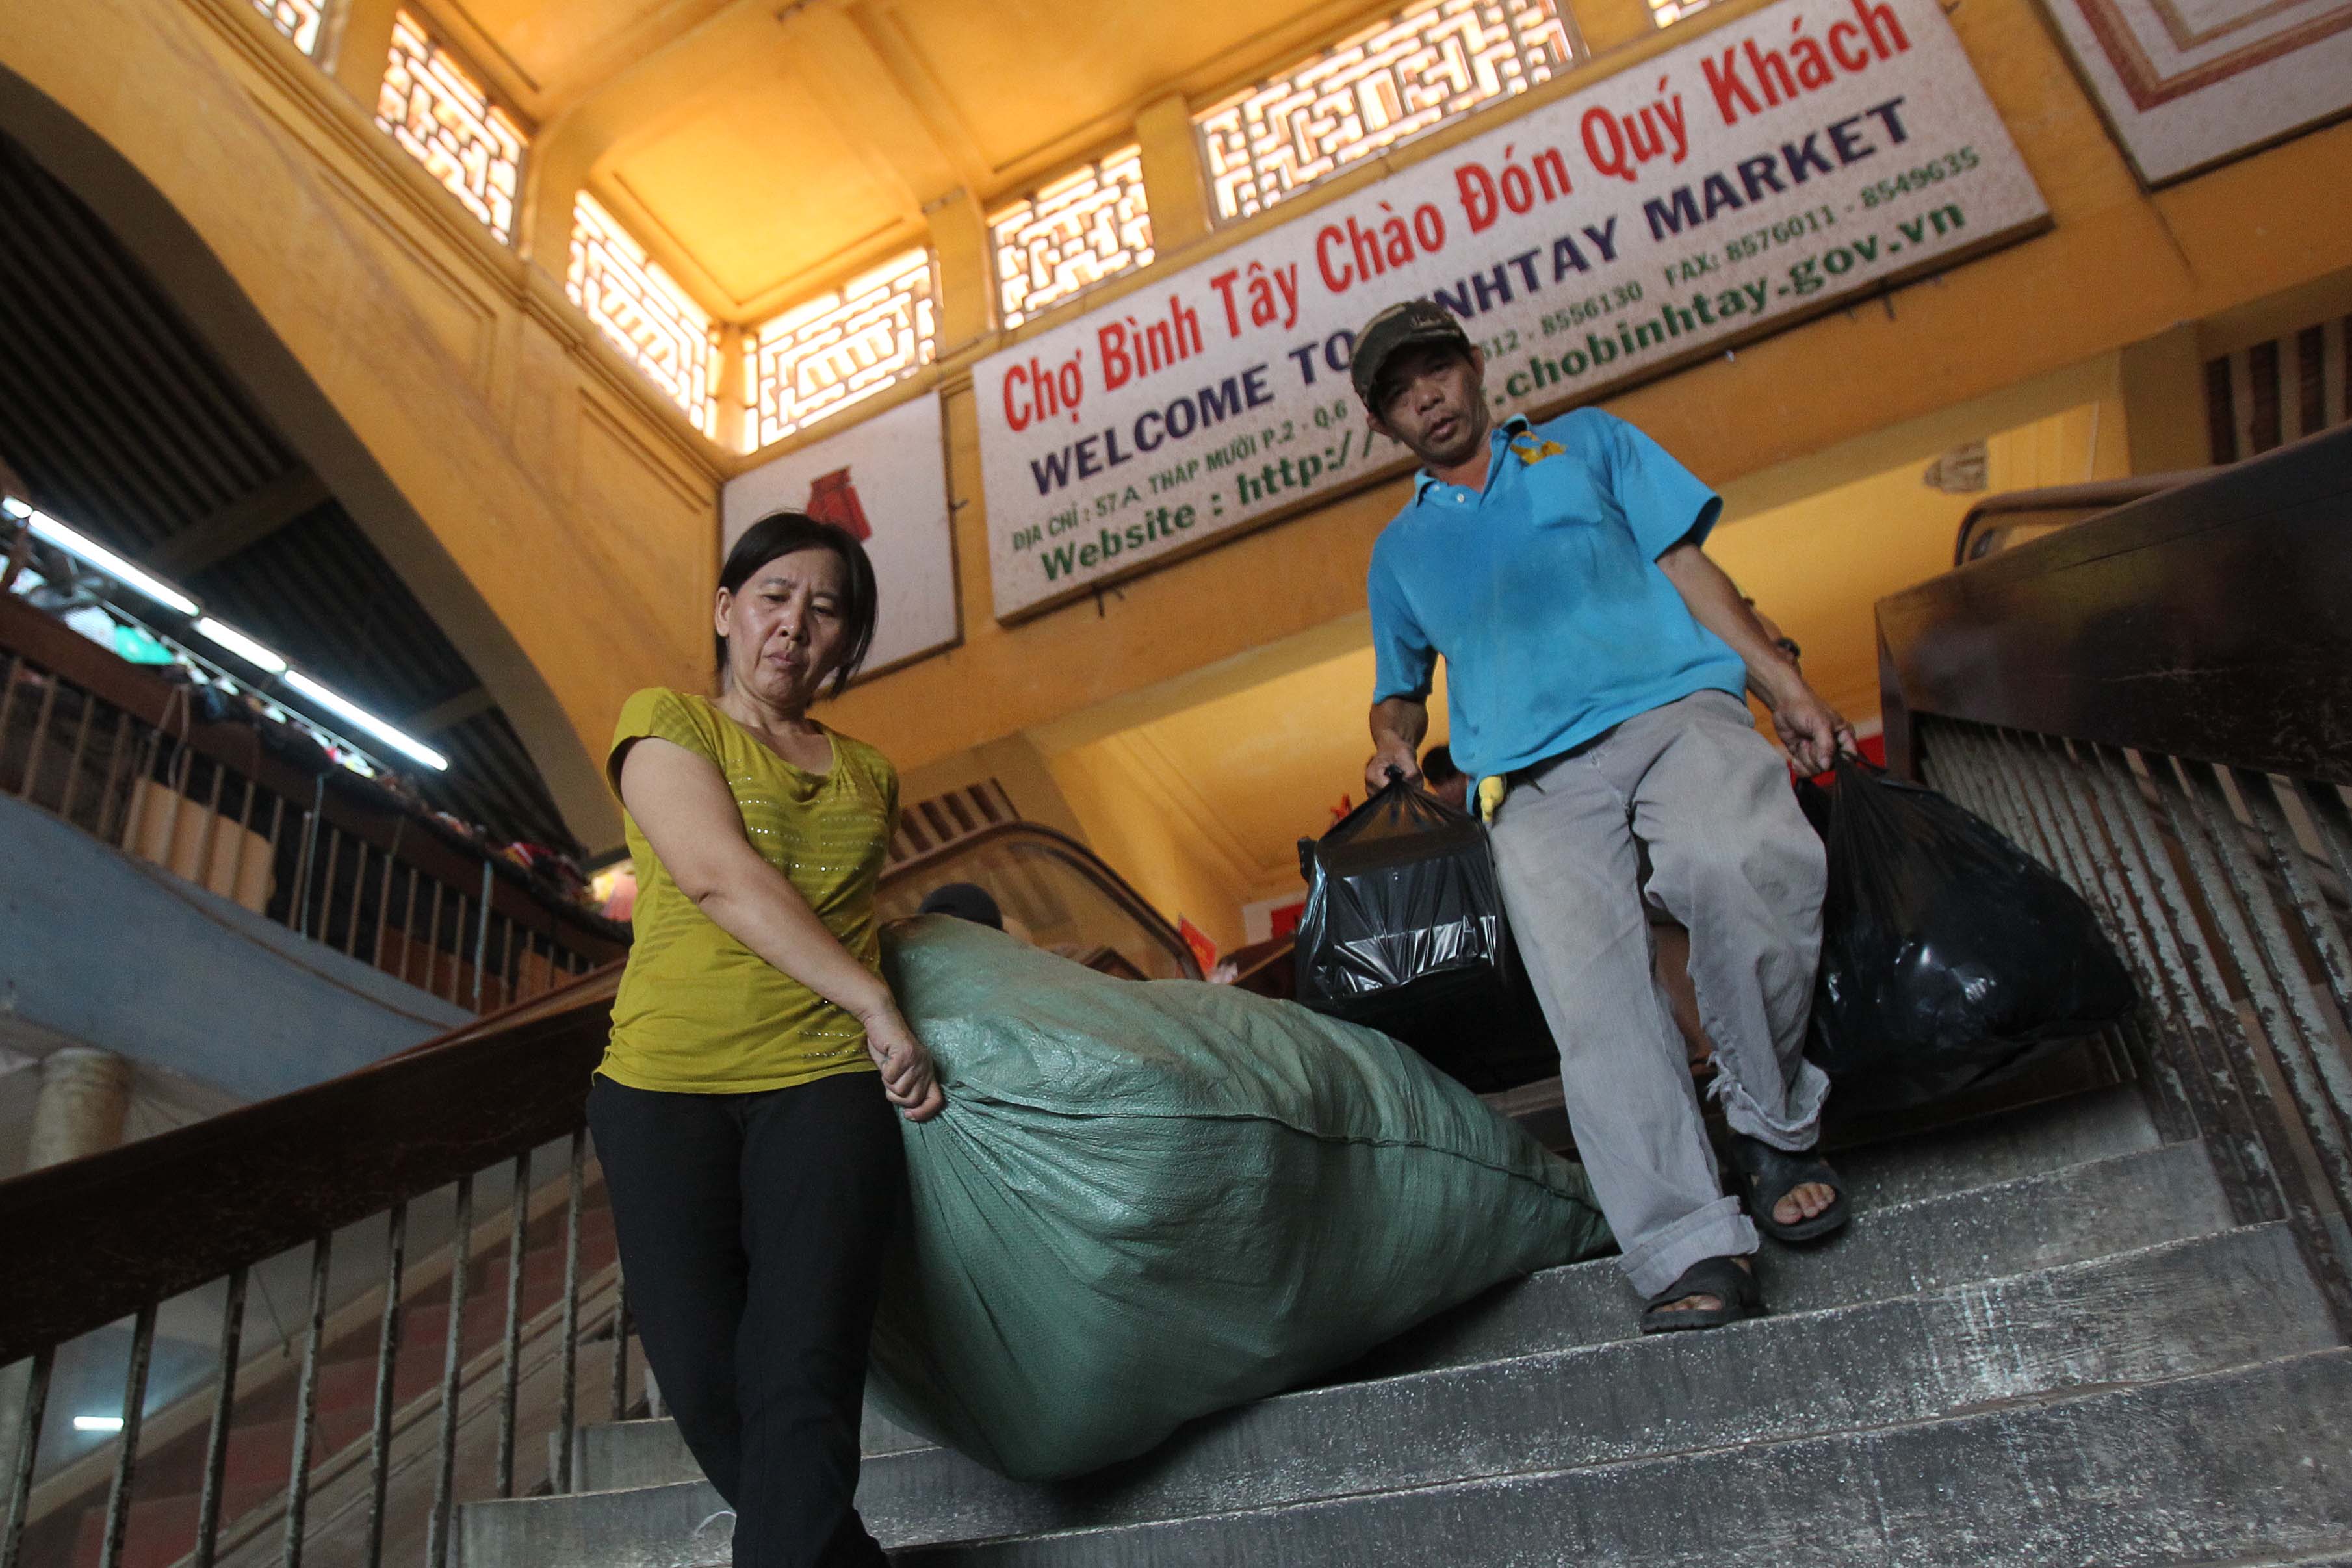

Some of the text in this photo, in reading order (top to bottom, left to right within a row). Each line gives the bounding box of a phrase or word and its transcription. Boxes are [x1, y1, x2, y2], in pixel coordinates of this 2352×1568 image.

[1003, 0, 1910, 433] Chợ Bình Tây Chào Đón Quý Khách
[1030, 96, 1909, 496] WELCOME TO NHTAY MARKET
[1013, 525, 1043, 552] ĐỊA
[1664, 252, 1720, 288] FAX:
[1041, 504, 1196, 581] Website
[1211, 493, 1223, 517] :
